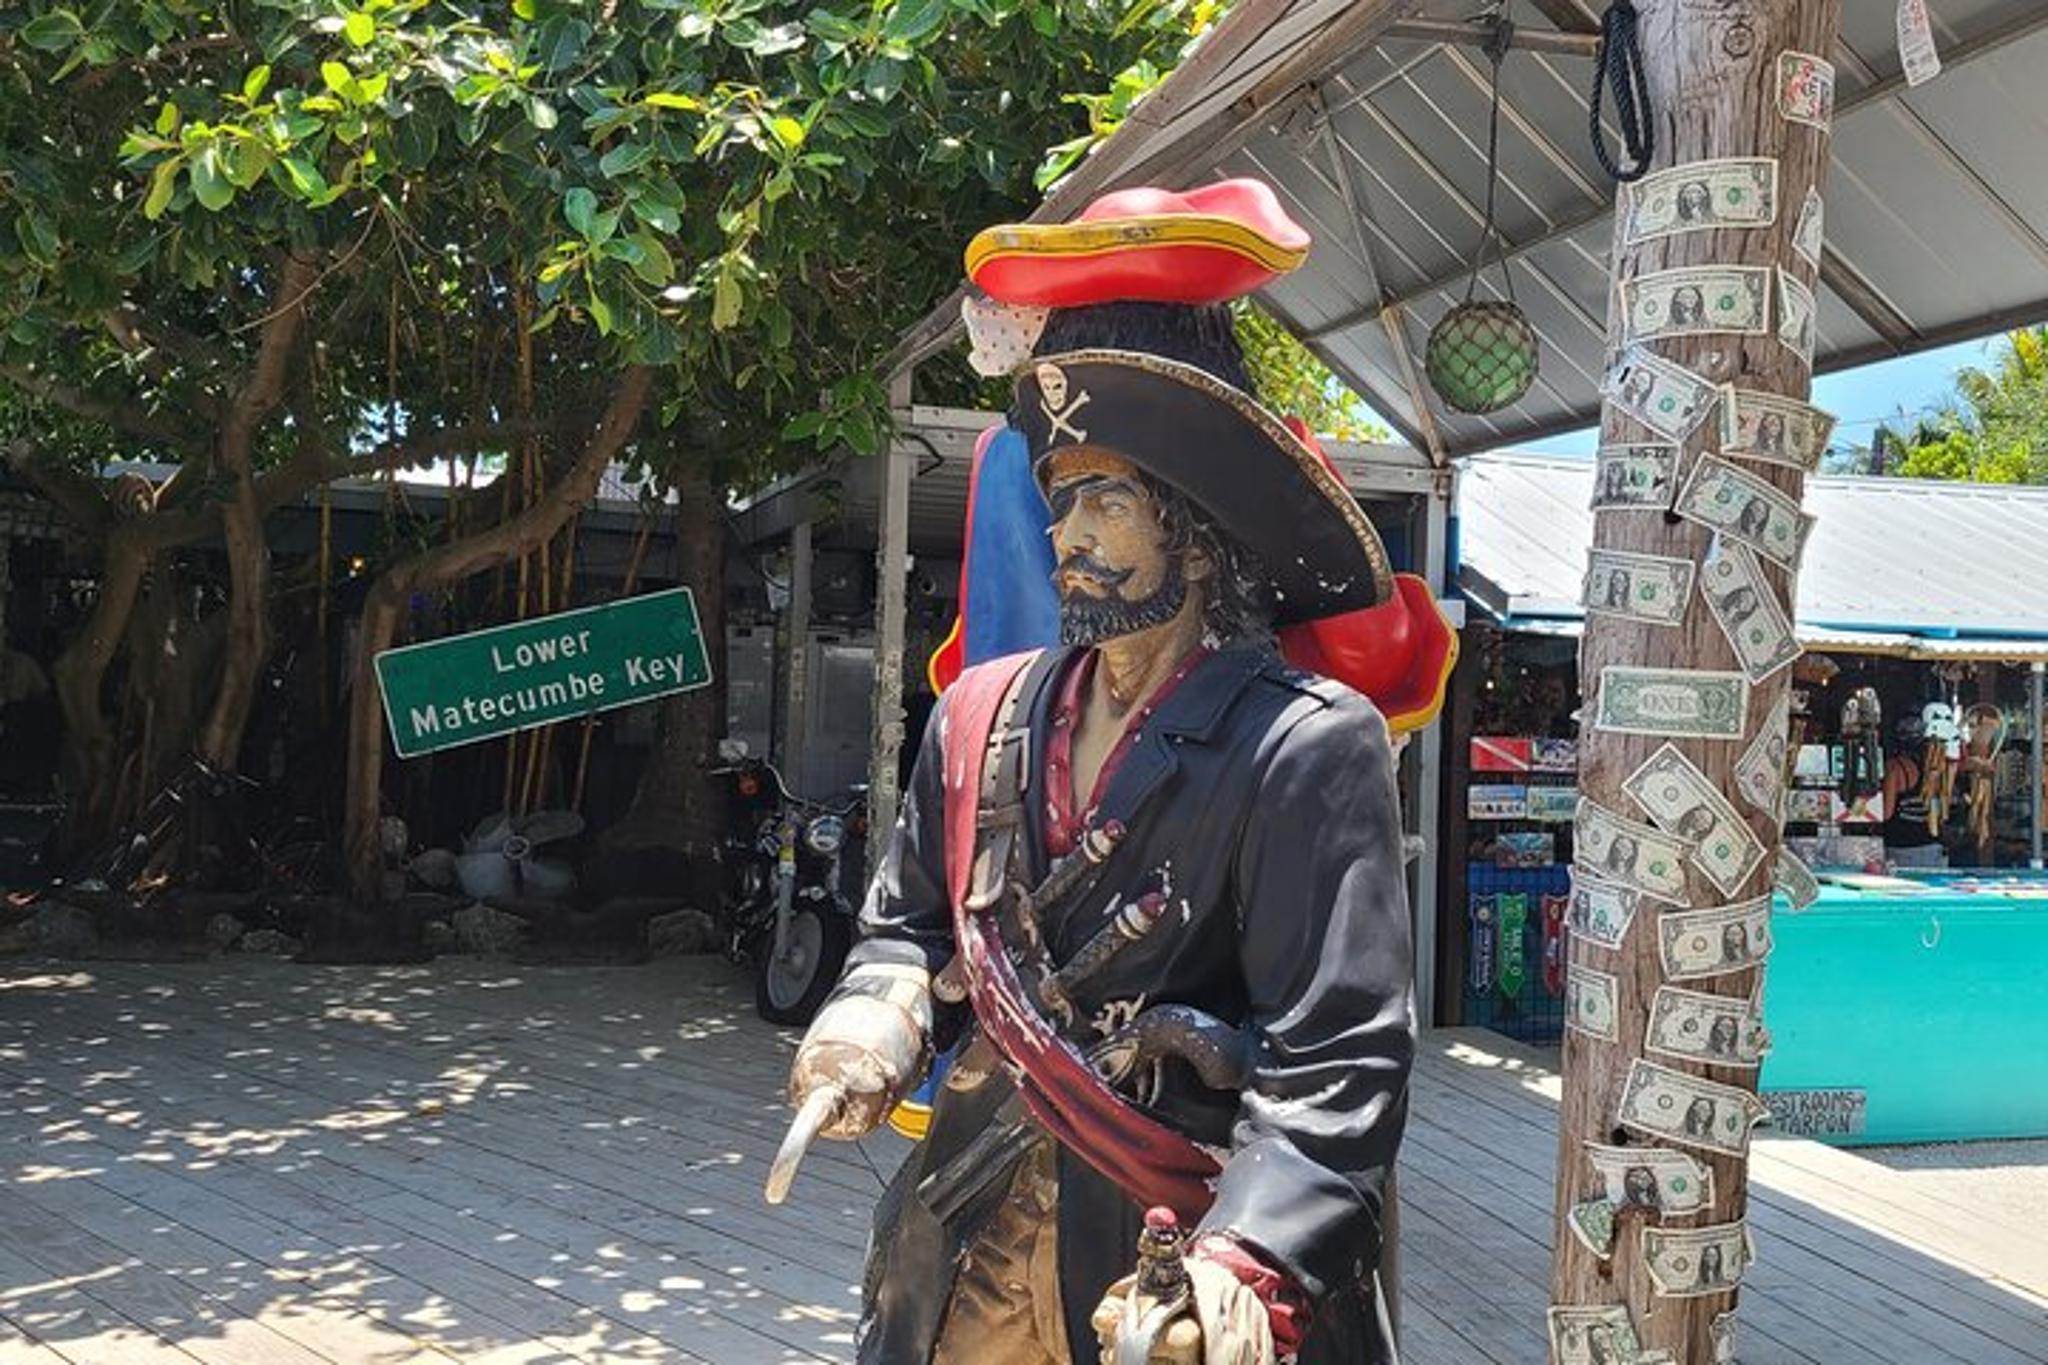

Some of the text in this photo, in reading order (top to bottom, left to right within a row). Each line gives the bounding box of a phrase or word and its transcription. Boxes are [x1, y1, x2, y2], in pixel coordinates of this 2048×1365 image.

[491, 630, 591, 673] Lower
[410, 653, 684, 738] Matecumbe Key
[1775, 1113, 1852, 1135] TARPON
